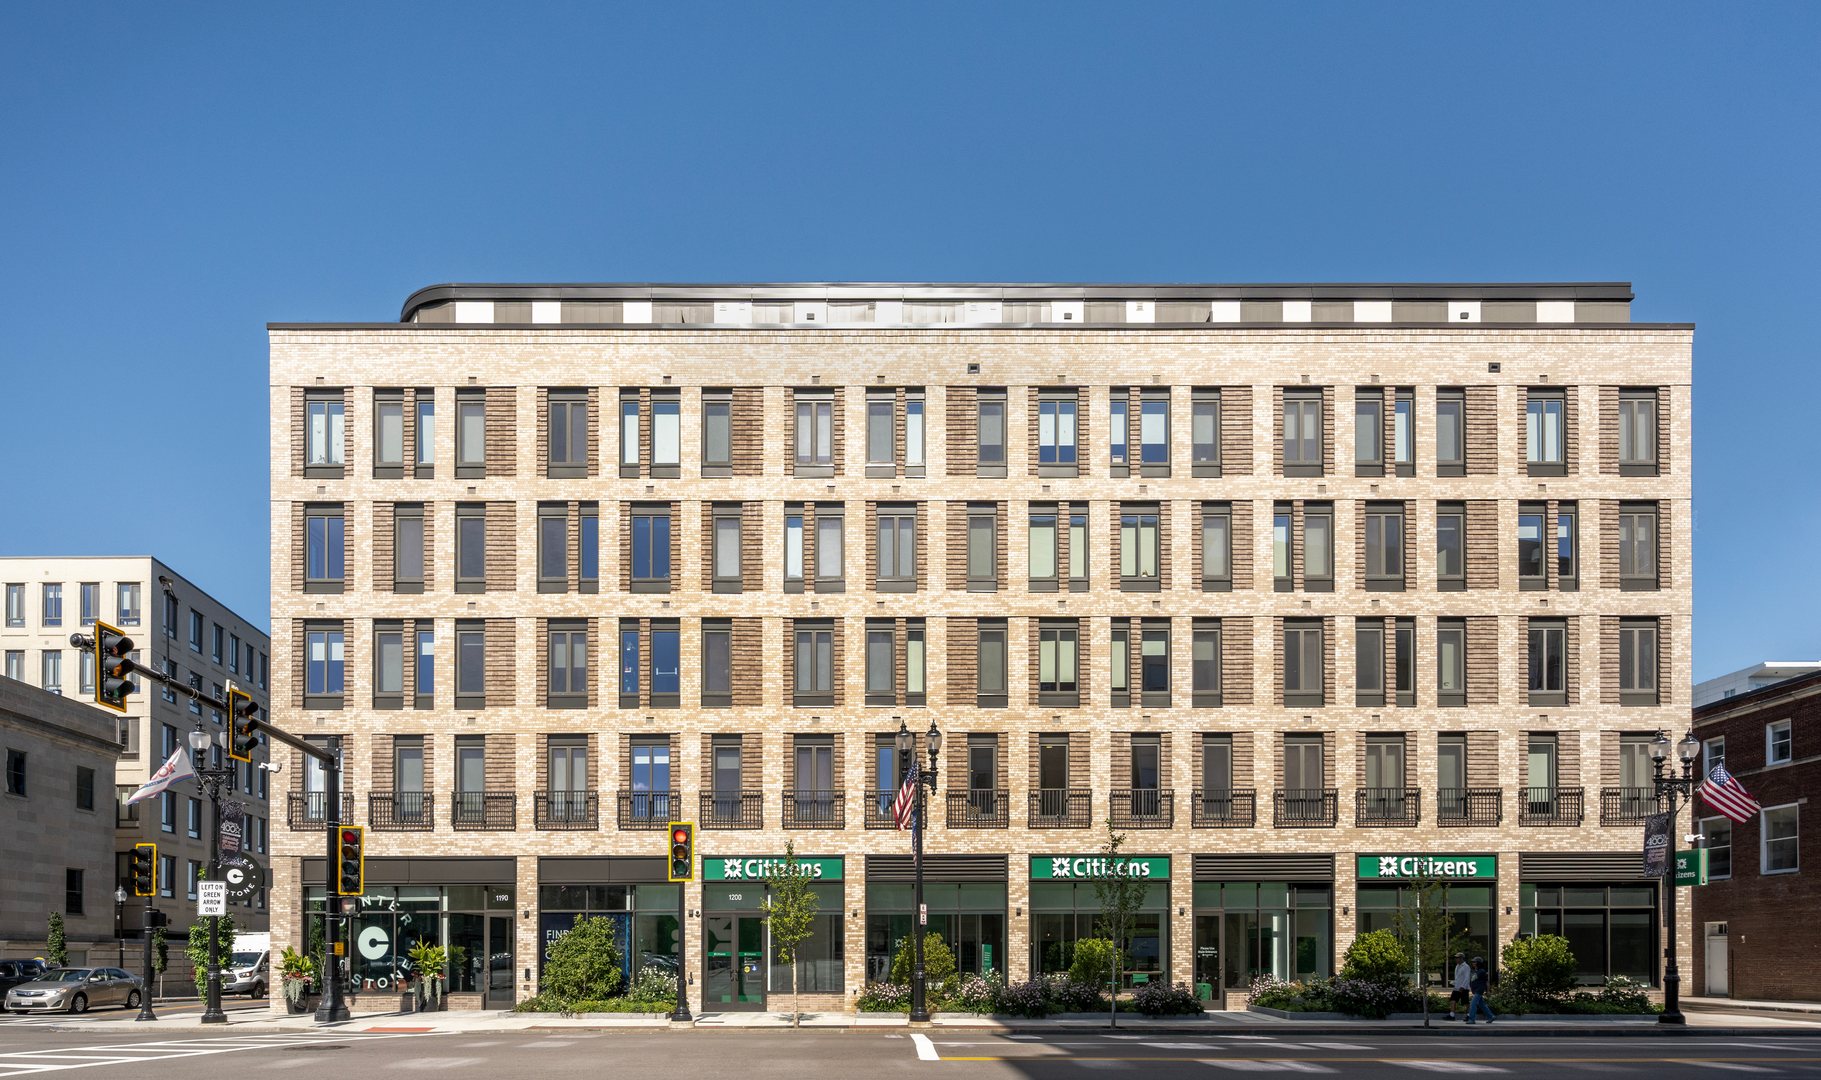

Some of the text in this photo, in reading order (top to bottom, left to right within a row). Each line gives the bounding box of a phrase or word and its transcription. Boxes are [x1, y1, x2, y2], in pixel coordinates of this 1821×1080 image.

[745, 859, 822, 877] Citizens
[1400, 857, 1477, 875] Citizens
[351, 958, 414, 990] STONE
